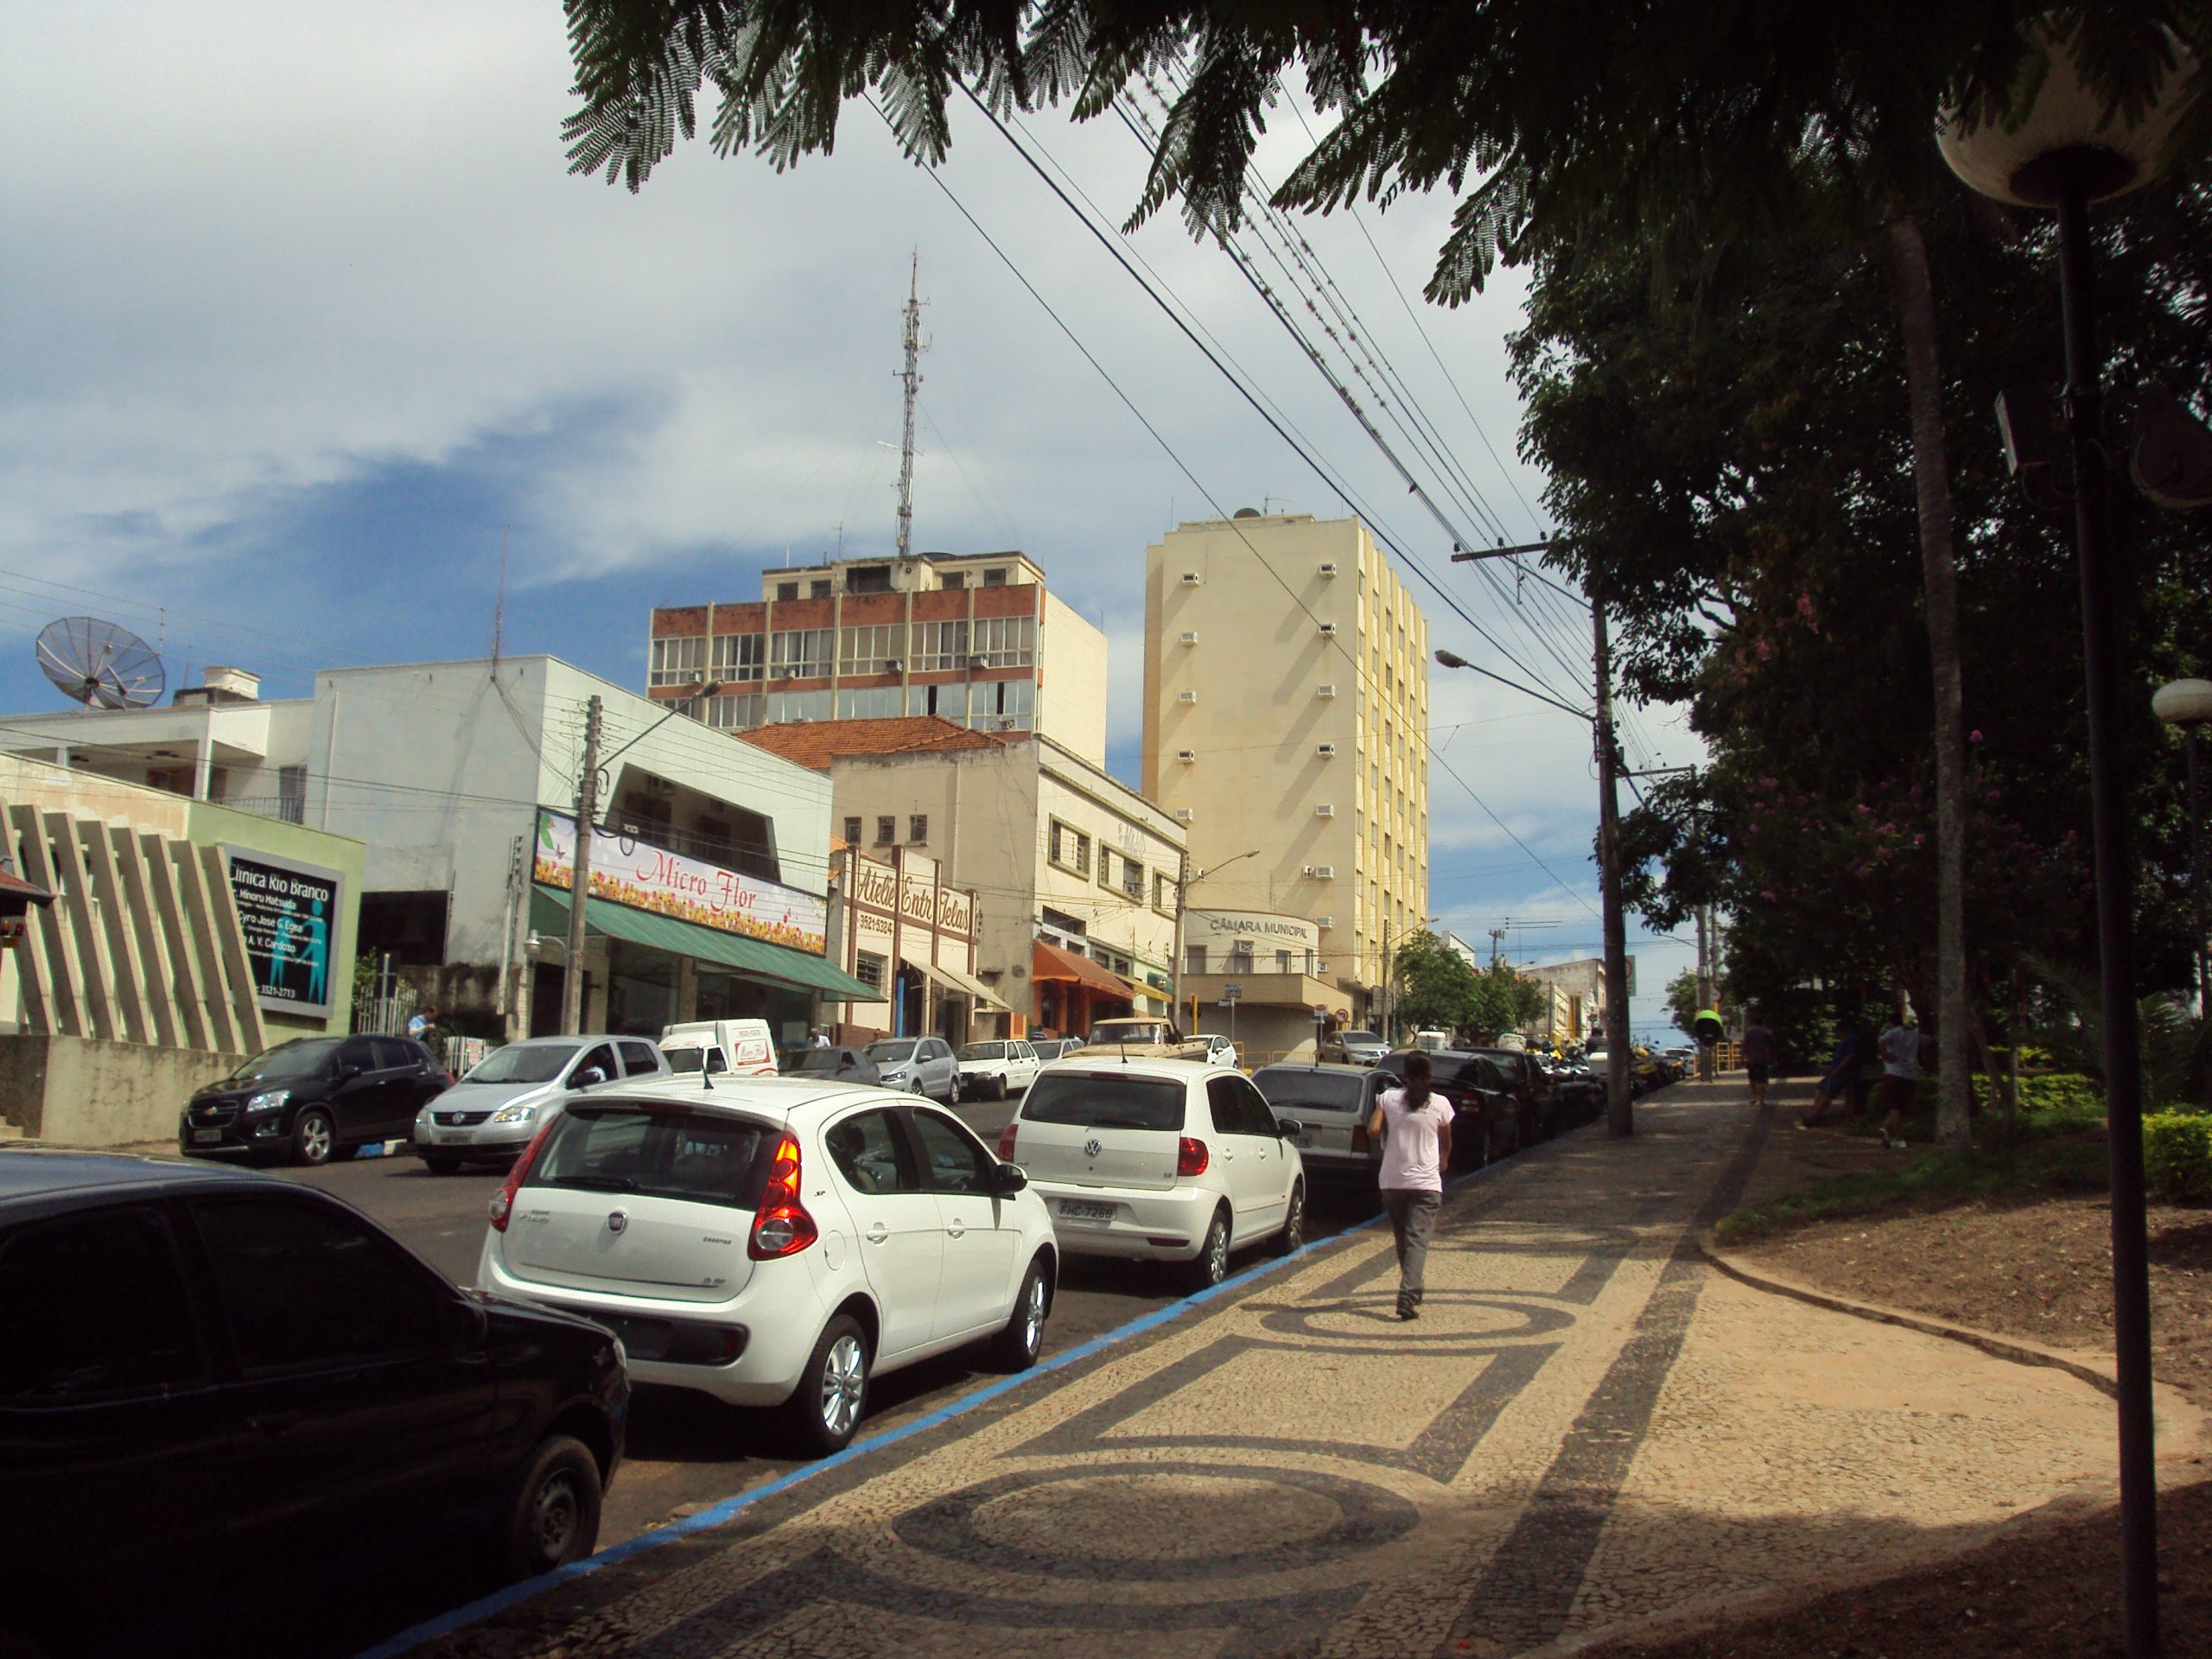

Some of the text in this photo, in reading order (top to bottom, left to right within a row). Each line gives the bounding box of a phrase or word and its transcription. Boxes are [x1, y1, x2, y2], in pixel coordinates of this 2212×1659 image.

[270, 873, 288, 893] Rio
[290, 878, 328, 901] Branco
[636, 851, 756, 912] Micro Flor
[239, 888, 297, 910] Minoru Matsuda
[940, 891, 969, 931] Telas
[258, 915, 276, 927] José
[285, 921, 303, 933] Egea
[1264, 922, 1308, 939] MUNICIPAL
[264, 938, 296, 952] Cardozo
[261, 984, 296, 999] 3521-2713
